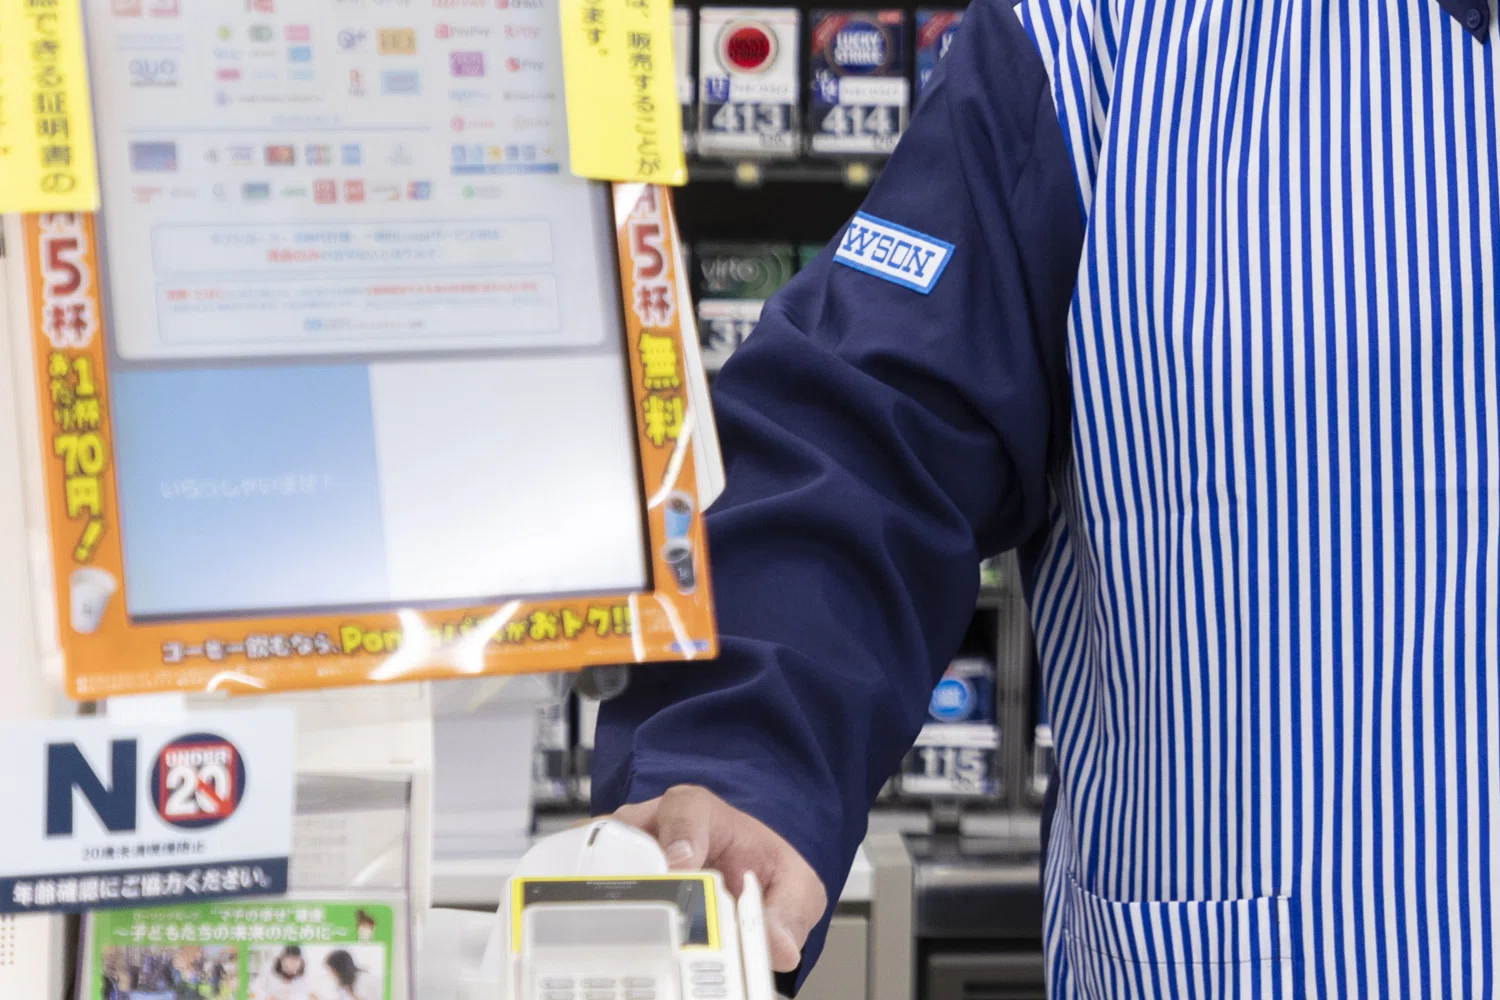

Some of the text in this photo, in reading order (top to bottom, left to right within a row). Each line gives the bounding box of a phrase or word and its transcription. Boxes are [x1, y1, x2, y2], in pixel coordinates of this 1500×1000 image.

[836, 32, 882, 48] LUCKY
[833, 48, 884, 66] STRIKE
[712, 104, 784, 134] 413
[821, 105, 892, 135] 414
[639, 333, 684, 447] 無料
[165, 749, 229, 768] UNDER
[920, 747, 984, 780] 115
[165, 765, 231, 816] 20
[13, 866, 272, 907] 年齢確認にご協力ください。
